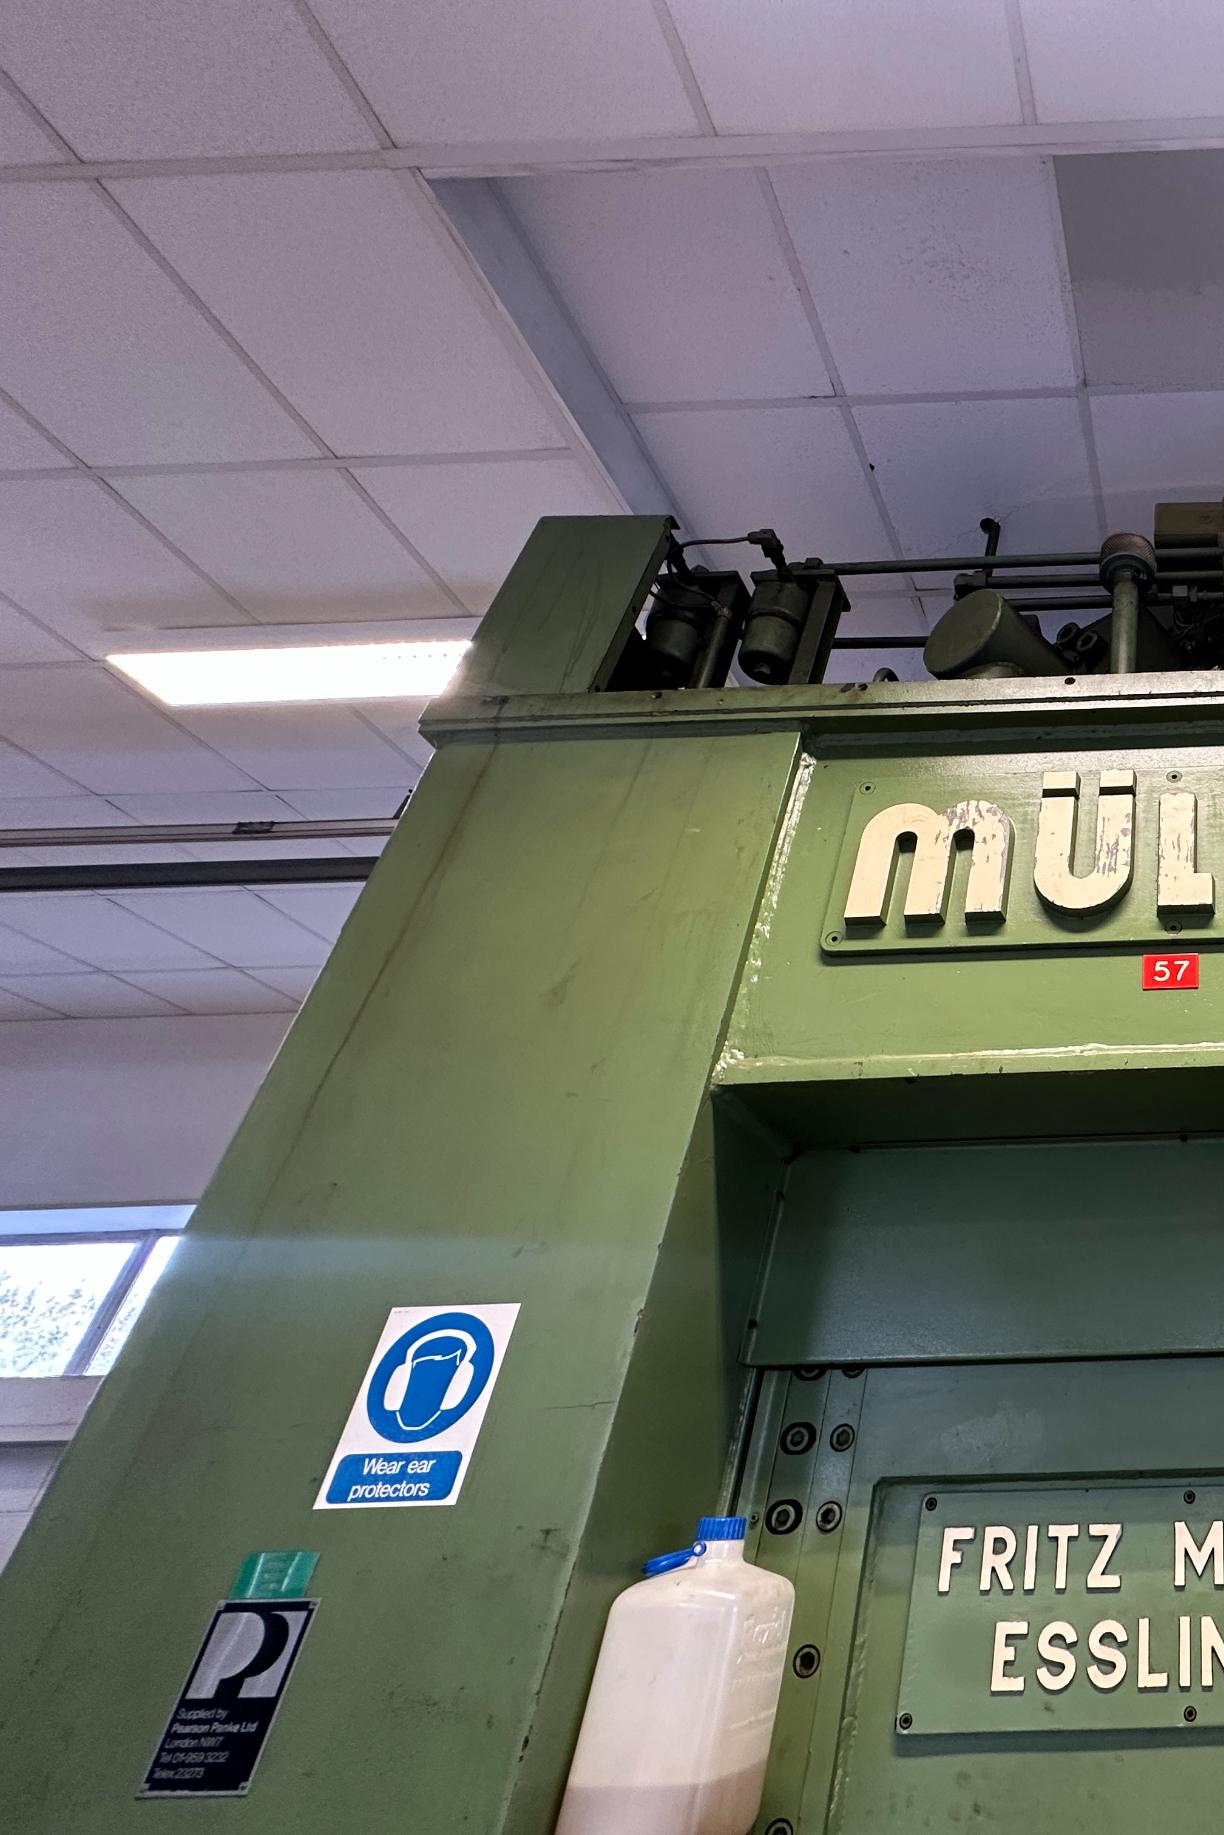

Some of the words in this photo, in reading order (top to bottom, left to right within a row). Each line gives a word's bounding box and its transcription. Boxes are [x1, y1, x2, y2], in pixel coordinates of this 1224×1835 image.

[1153, 960, 1190, 982] 57
[363, 1458, 405, 1475] Wear
[407, 1459, 436, 1474] ear
[347, 1481, 431, 1502] protectors
[937, 1523, 1123, 1593] FRITZ
[177, 1708, 216, 1720] Supplied
[215, 1708, 229, 1720] by
[240, 1721, 259, 1733] Ltd
[164, 1737, 198, 1749] London
